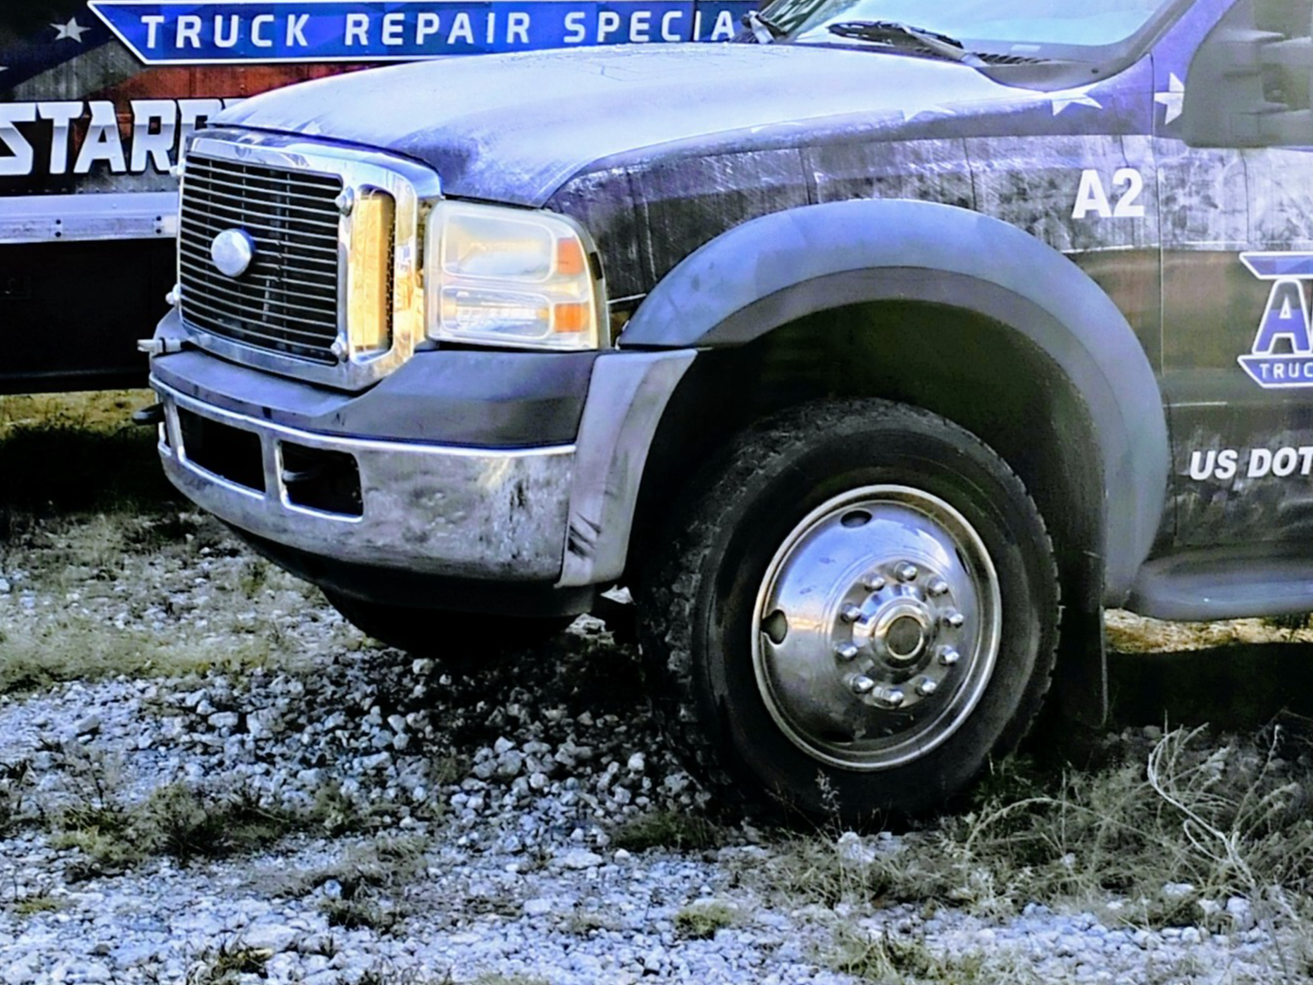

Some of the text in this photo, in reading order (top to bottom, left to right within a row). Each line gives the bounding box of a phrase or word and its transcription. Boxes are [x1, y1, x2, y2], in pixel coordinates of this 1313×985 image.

[141, 10, 735, 49] TRUCK REPAIR SPECIA
[1071, 167, 1145, 219] A2
[1189, 449, 1238, 480] US
